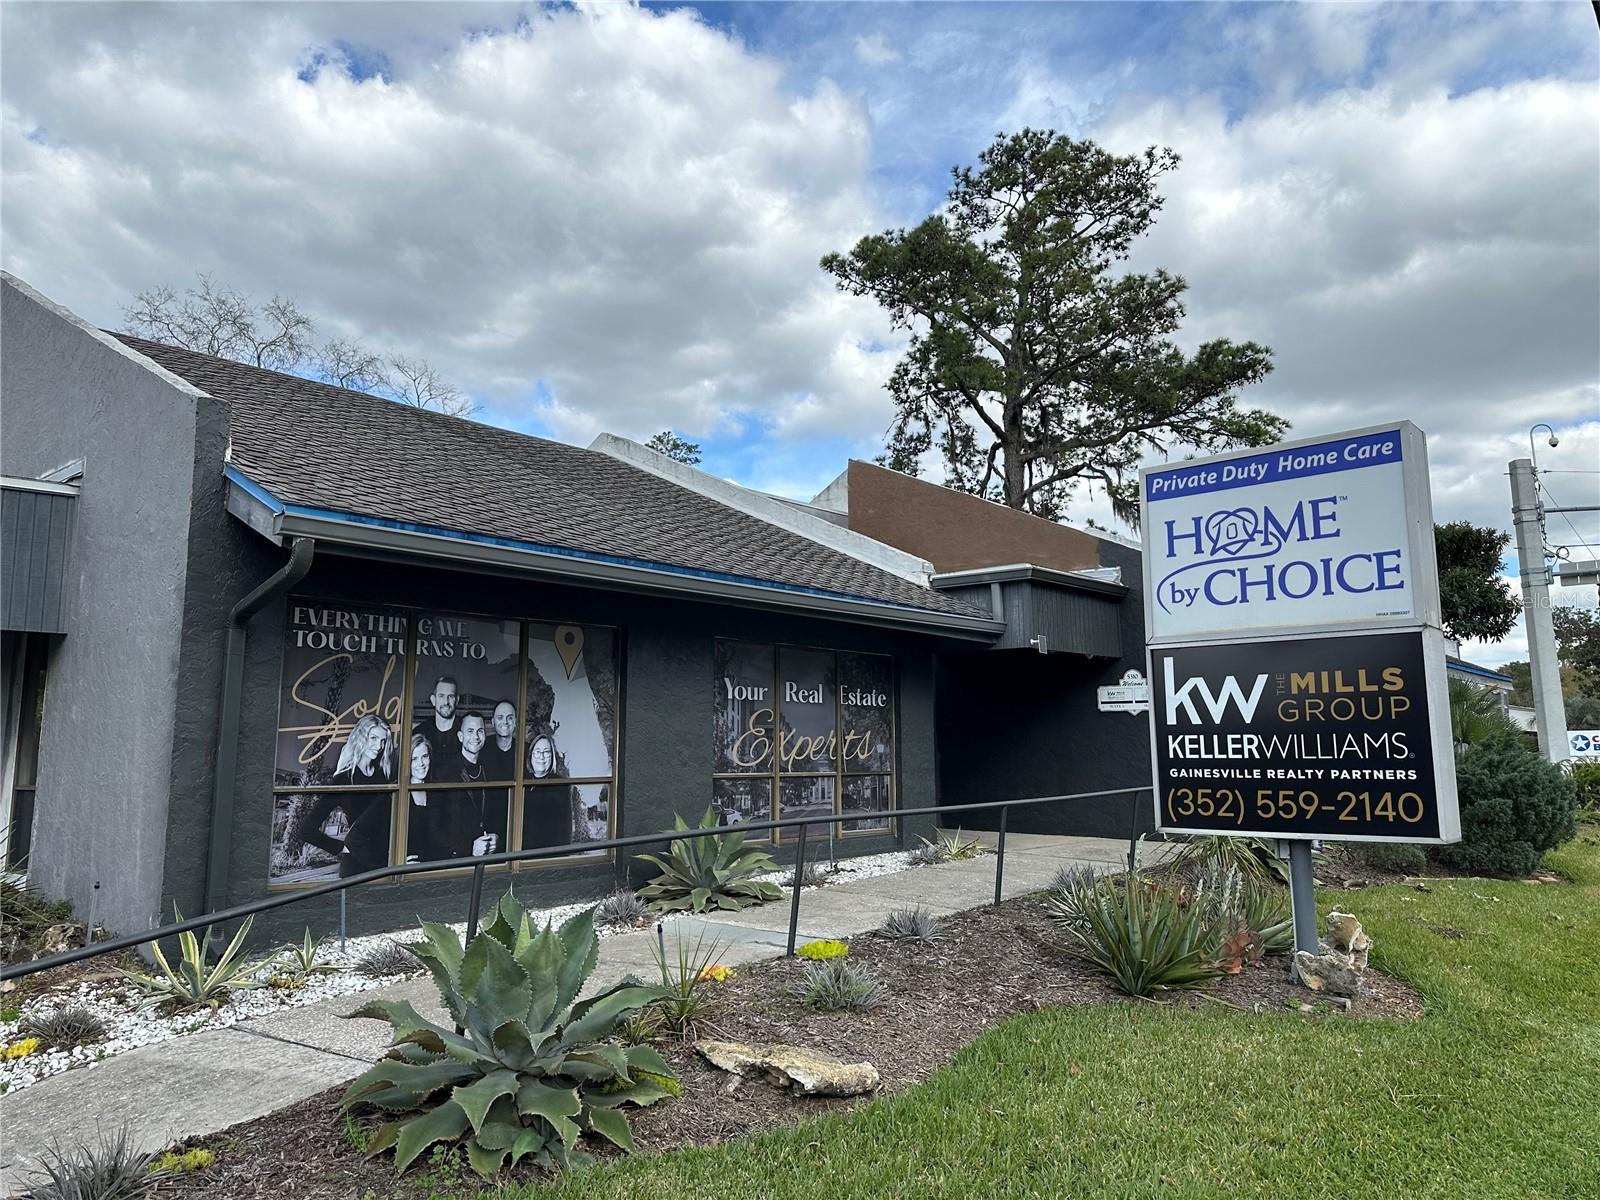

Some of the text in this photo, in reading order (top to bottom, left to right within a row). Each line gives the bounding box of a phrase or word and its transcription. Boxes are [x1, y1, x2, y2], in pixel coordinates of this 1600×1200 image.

[1151, 440, 1394, 495] Private Duty Home Care
[1164, 495, 1341, 558] HOME
[1169, 549, 1405, 607] by CHOICE
[293, 606, 470, 638] EVERYTHING WE
[293, 629, 487, 660] TOUCH TURNS TO
[724, 677, 887, 707] Your Real Estate
[1163, 656, 1269, 725] kw
[1276, 672, 1286, 696] THE
[1290, 667, 1405, 695] MILLS
[1277, 697, 1410, 722] GROUP
[732, 708, 875, 773] Experts
[1169, 768, 1417, 780] GAINESVILLE REALTY PARTNERS
[1167, 788, 1424, 825] (352) 559-2140
